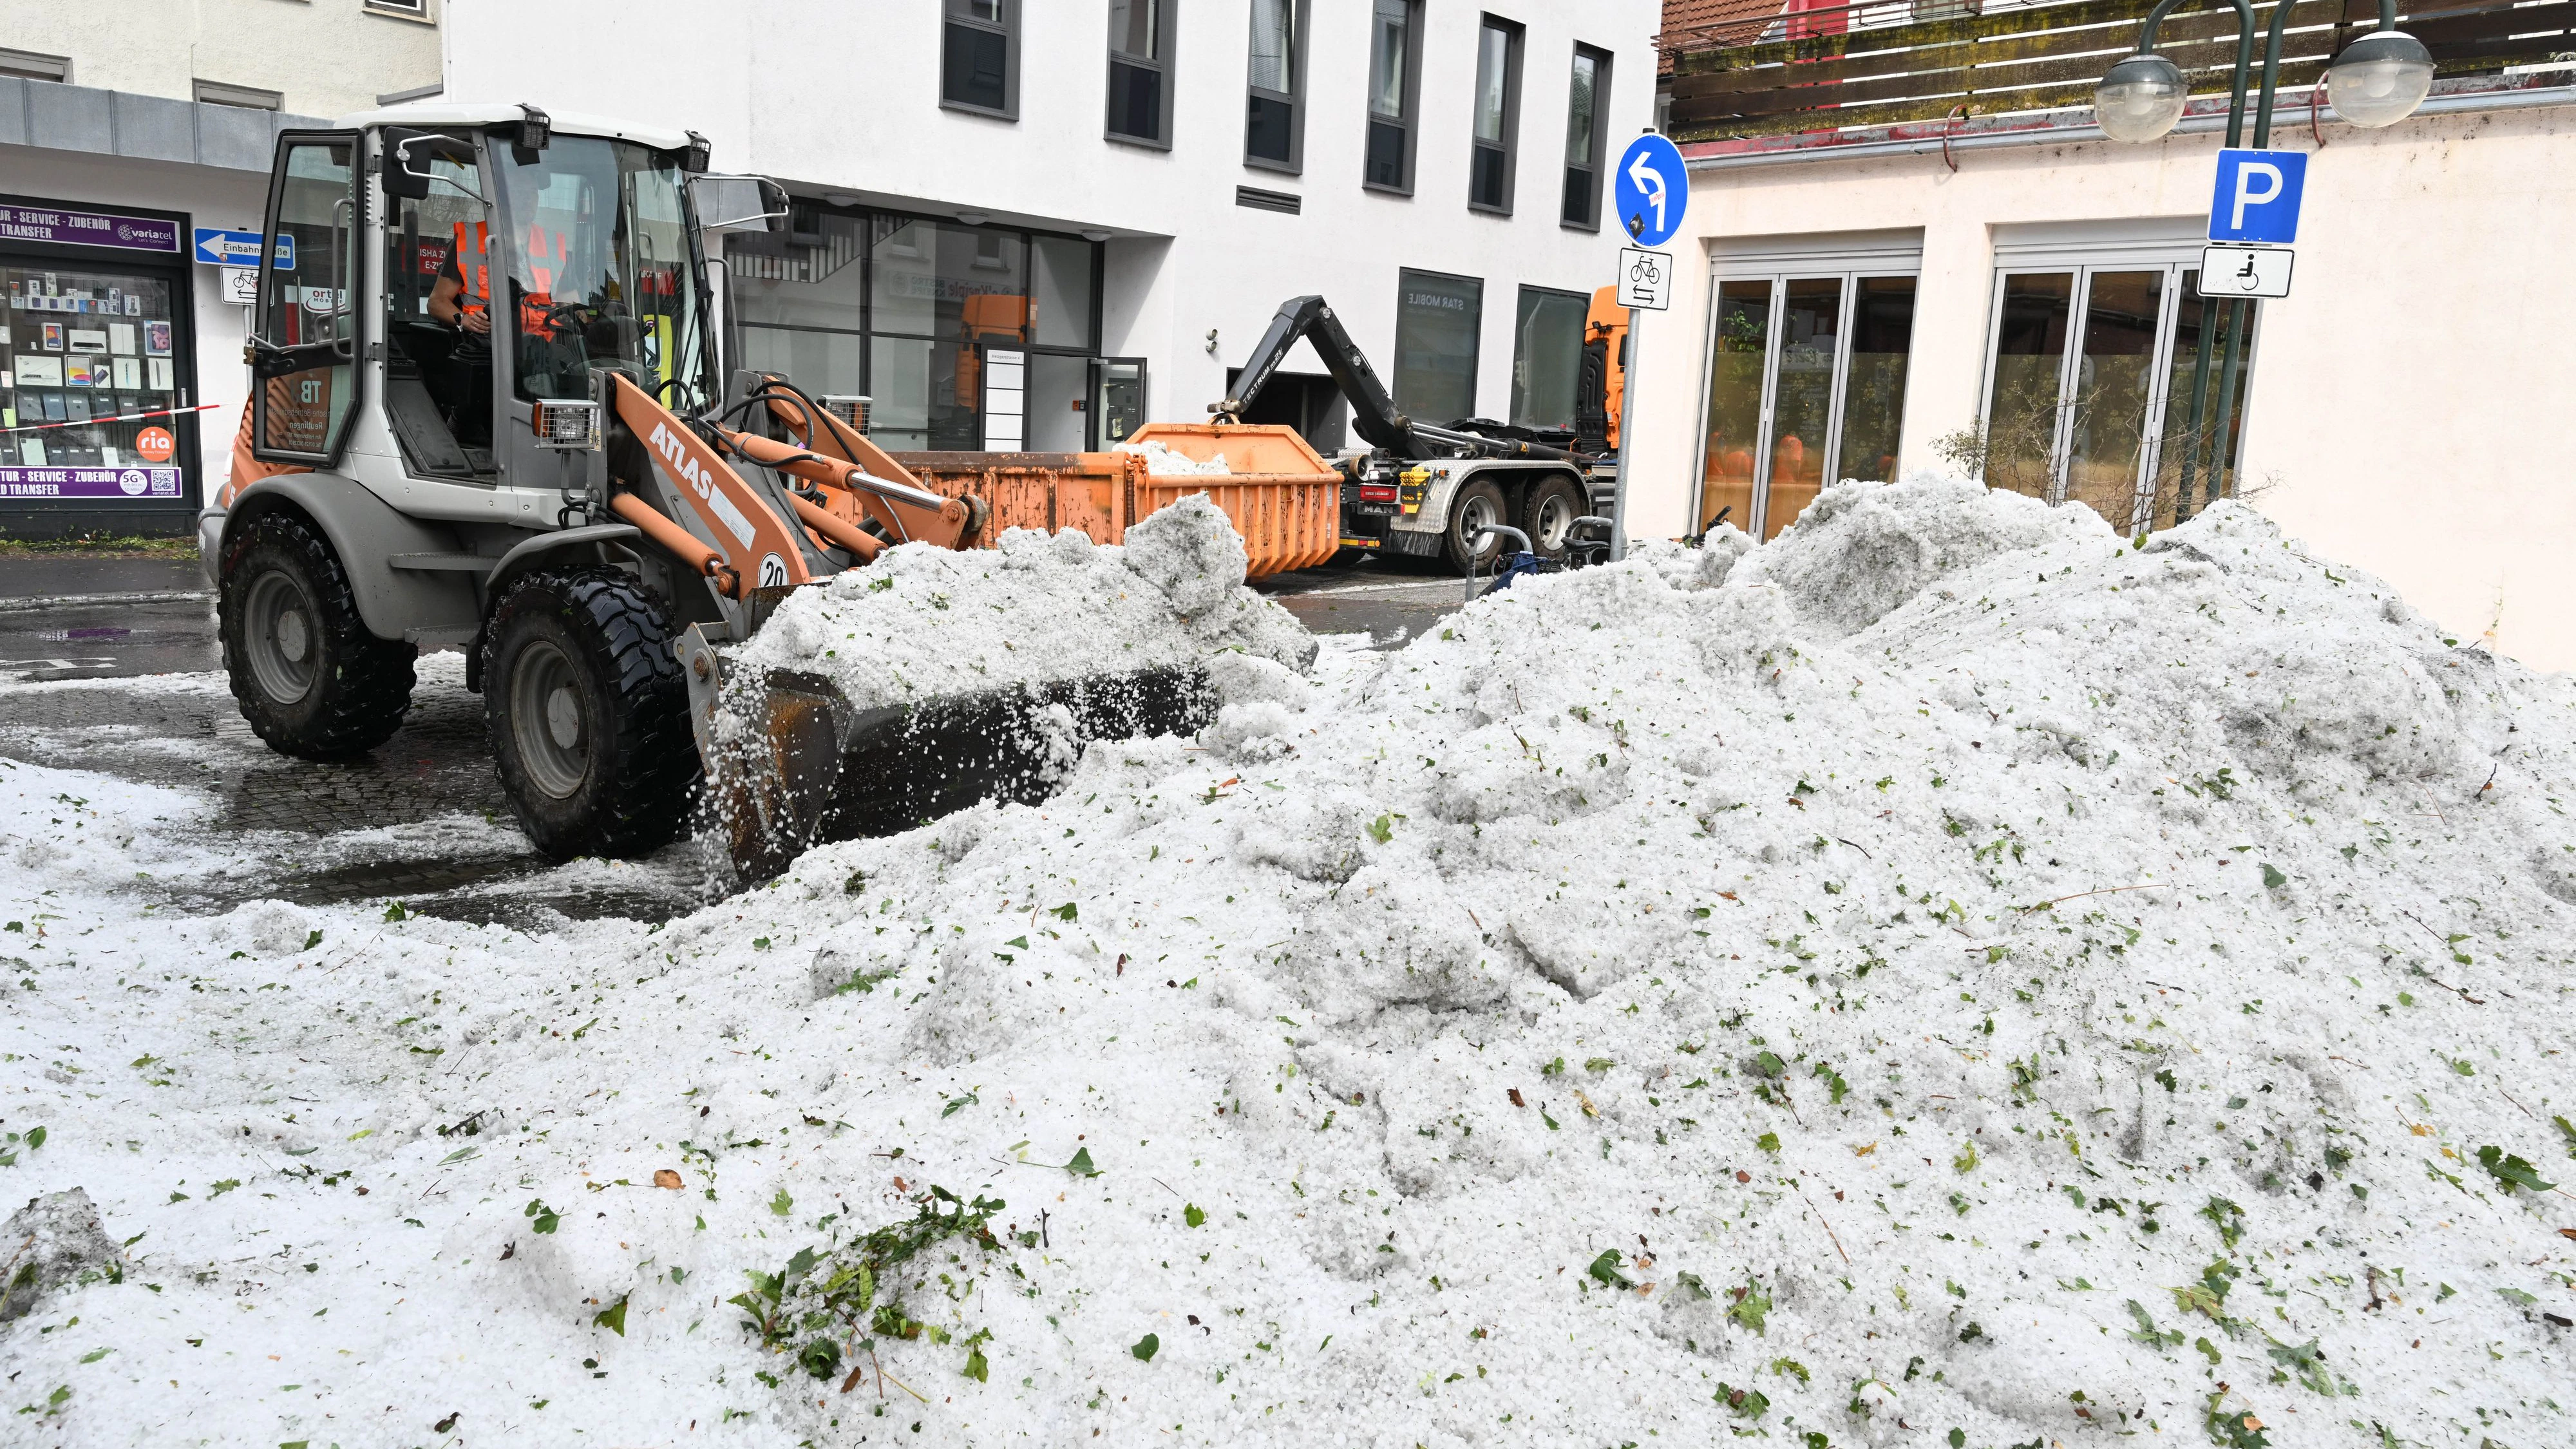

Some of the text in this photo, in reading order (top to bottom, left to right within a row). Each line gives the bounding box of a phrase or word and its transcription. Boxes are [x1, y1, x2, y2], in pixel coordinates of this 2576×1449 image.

[2230, 162, 2283, 230] P
[19, 211, 61, 226] SERVICE
[68, 217, 111, 231] ZUBEHÖR
[0, 223, 52, 239] TRANSFER
[131, 229, 173, 240] variatel
[223, 243, 288, 256] Einbahnße
[312, 290, 343, 299] ortl
[1243, 366, 1270, 404] TECTRUM
[141, 431, 170, 449] ria
[649, 421, 712, 500] ATLAS
[27, 471, 68, 482] SERVICE
[75, 469, 117, 482] ZUBEHÖR
[123, 474, 138, 483] 5G
[9, 484, 60, 495] TRANSFER
[1364, 505, 1393, 514] MAN
[764, 561, 784, 587] 20
